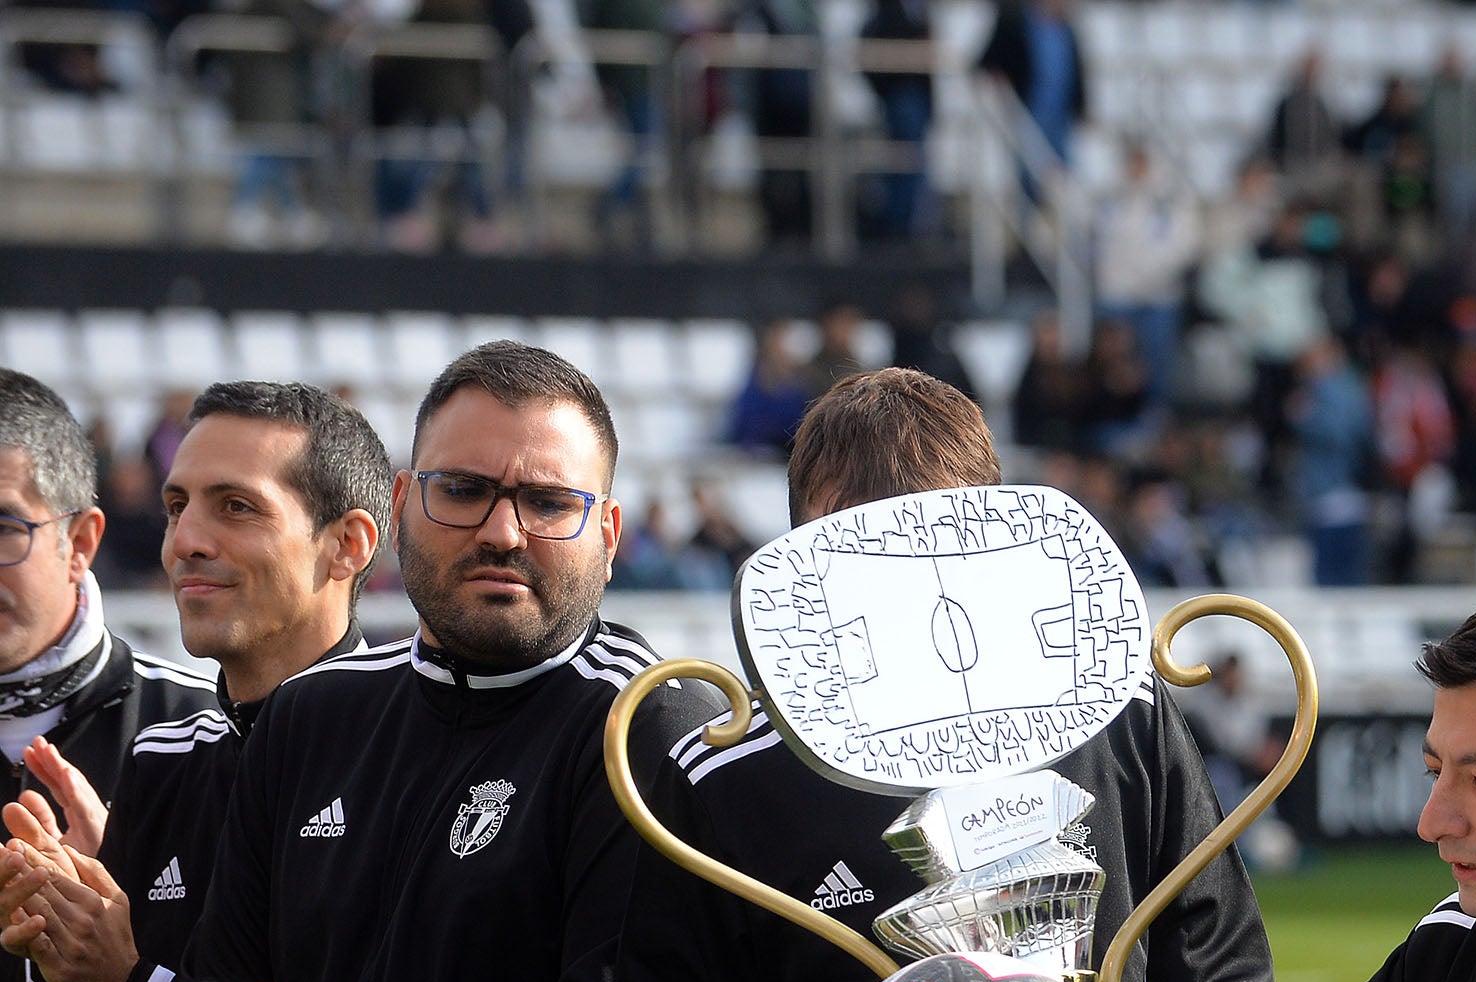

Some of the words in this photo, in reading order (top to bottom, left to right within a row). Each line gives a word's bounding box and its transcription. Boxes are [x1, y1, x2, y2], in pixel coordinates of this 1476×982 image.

[961, 793, 1044, 832] CAMPEÓN
[299, 821, 346, 838] adidas
[148, 883, 186, 901] adidas
[810, 888, 875, 911] adidas
